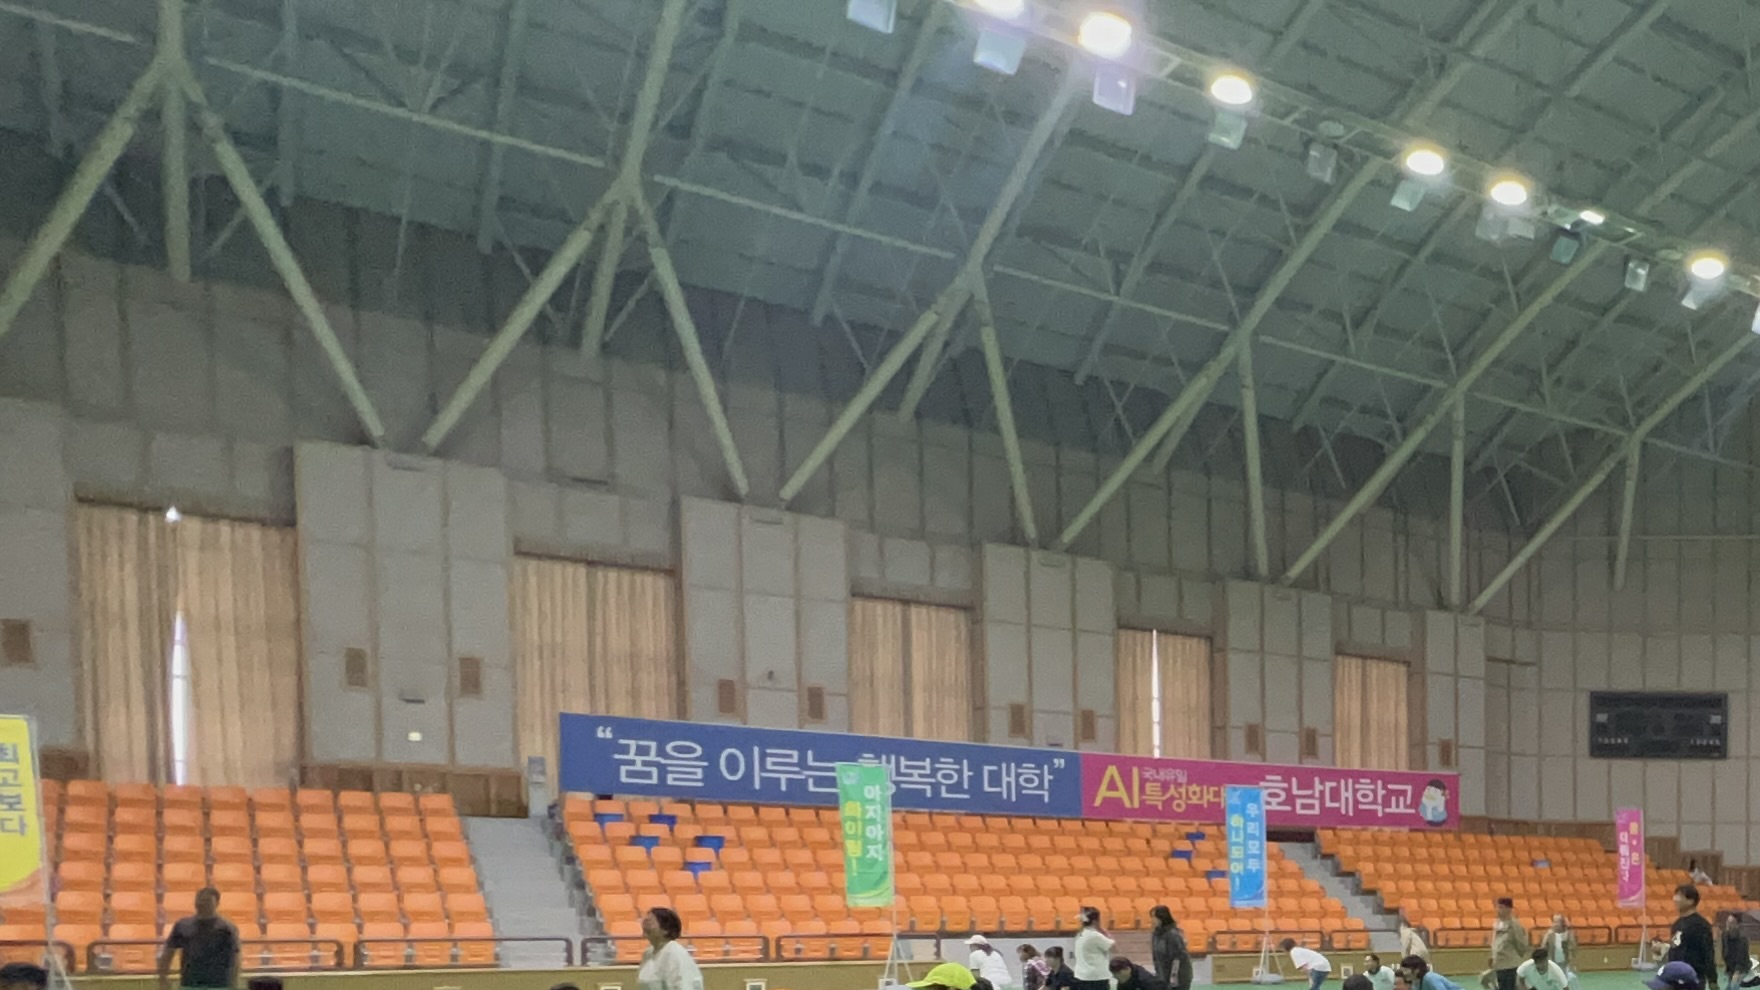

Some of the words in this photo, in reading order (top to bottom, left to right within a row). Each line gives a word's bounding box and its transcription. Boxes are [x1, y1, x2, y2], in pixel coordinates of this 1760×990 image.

[596, 726, 709, 787] “꿈을
[719, 745, 841, 793] 이루는
[983, 758, 1065, 803] 대학”
[1093, 765, 1139, 808] AI
[1259, 774, 1416, 817] 호남대학교
[1142, 767, 1187, 783] 국내유일
[1245, 803, 1261, 873] 우리모두
